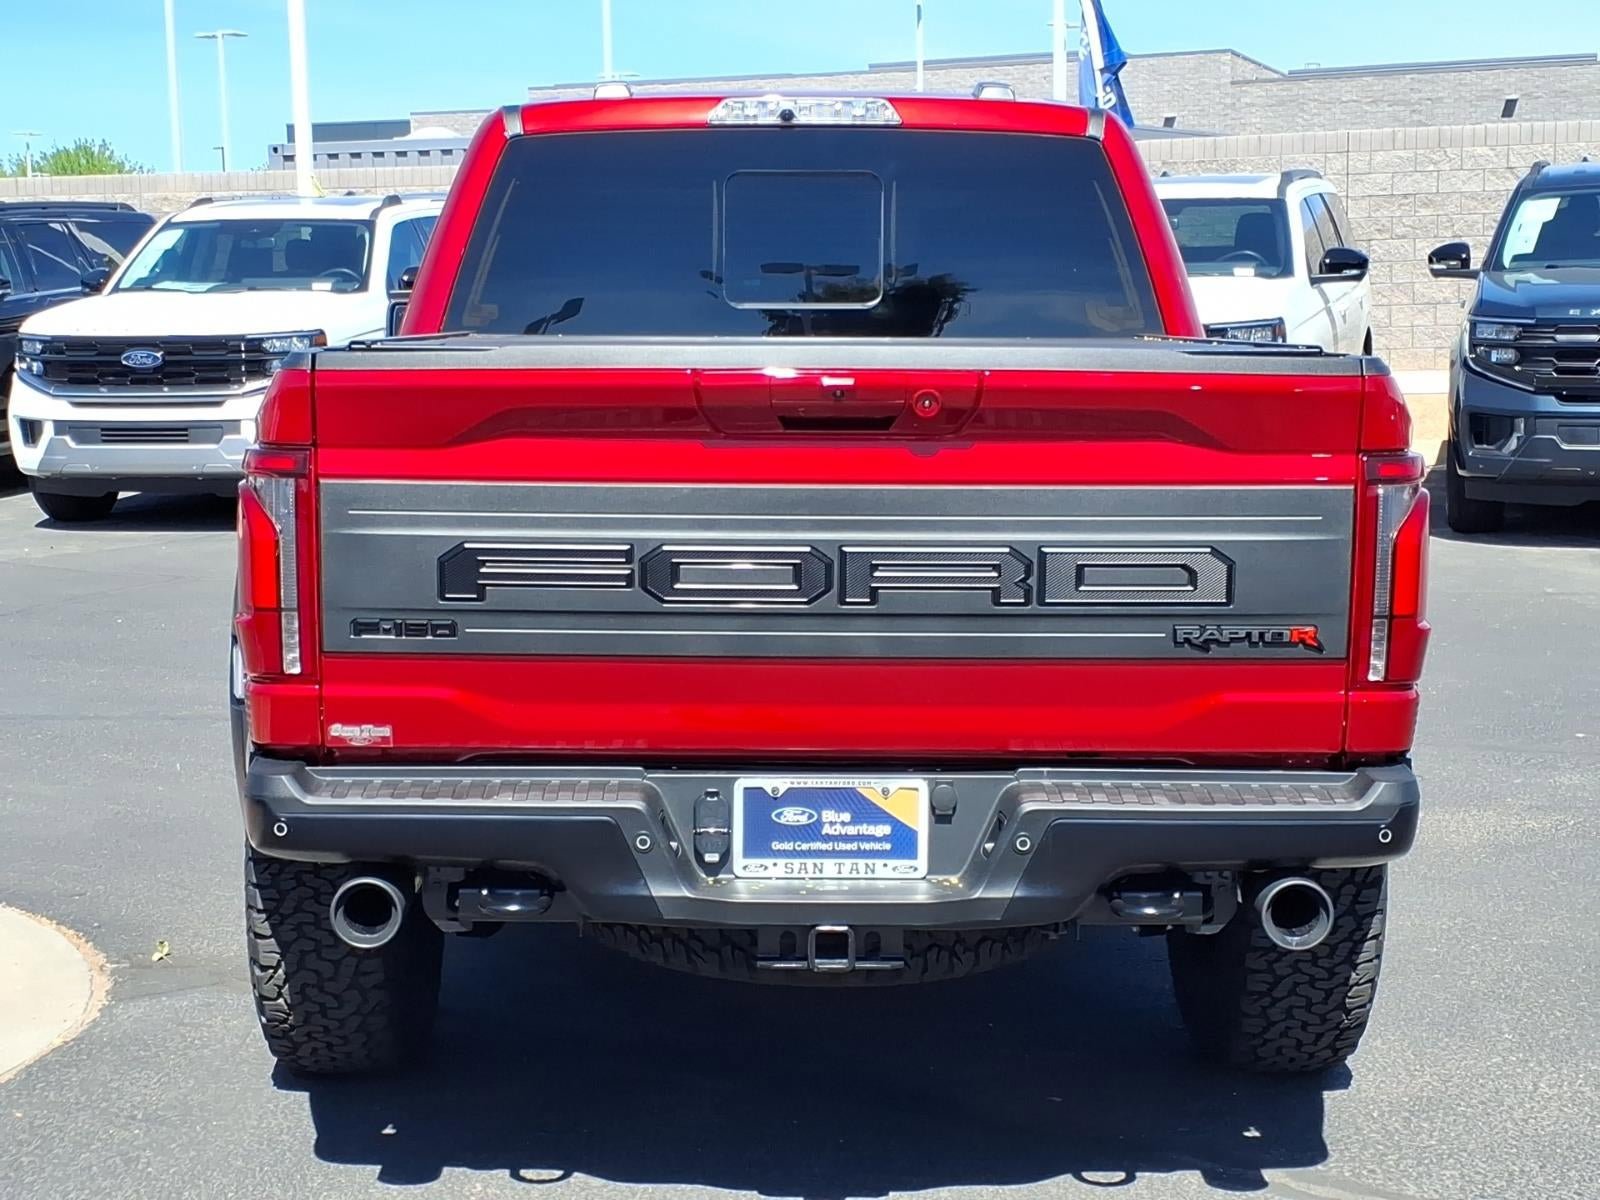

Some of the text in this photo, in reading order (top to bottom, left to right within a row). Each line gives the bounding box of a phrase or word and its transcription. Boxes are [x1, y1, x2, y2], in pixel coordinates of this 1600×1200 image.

[437, 541, 1235, 606] FORD
[1173, 624, 1326, 654] RAPTOR
[821, 809, 851, 823] Blue
[821, 823, 892, 837] Advantage
[771, 840, 892, 851] Gold Certified Used Vehicle
[783, 862, 825, 875] SAN
[834, 862, 876, 875] TAN
